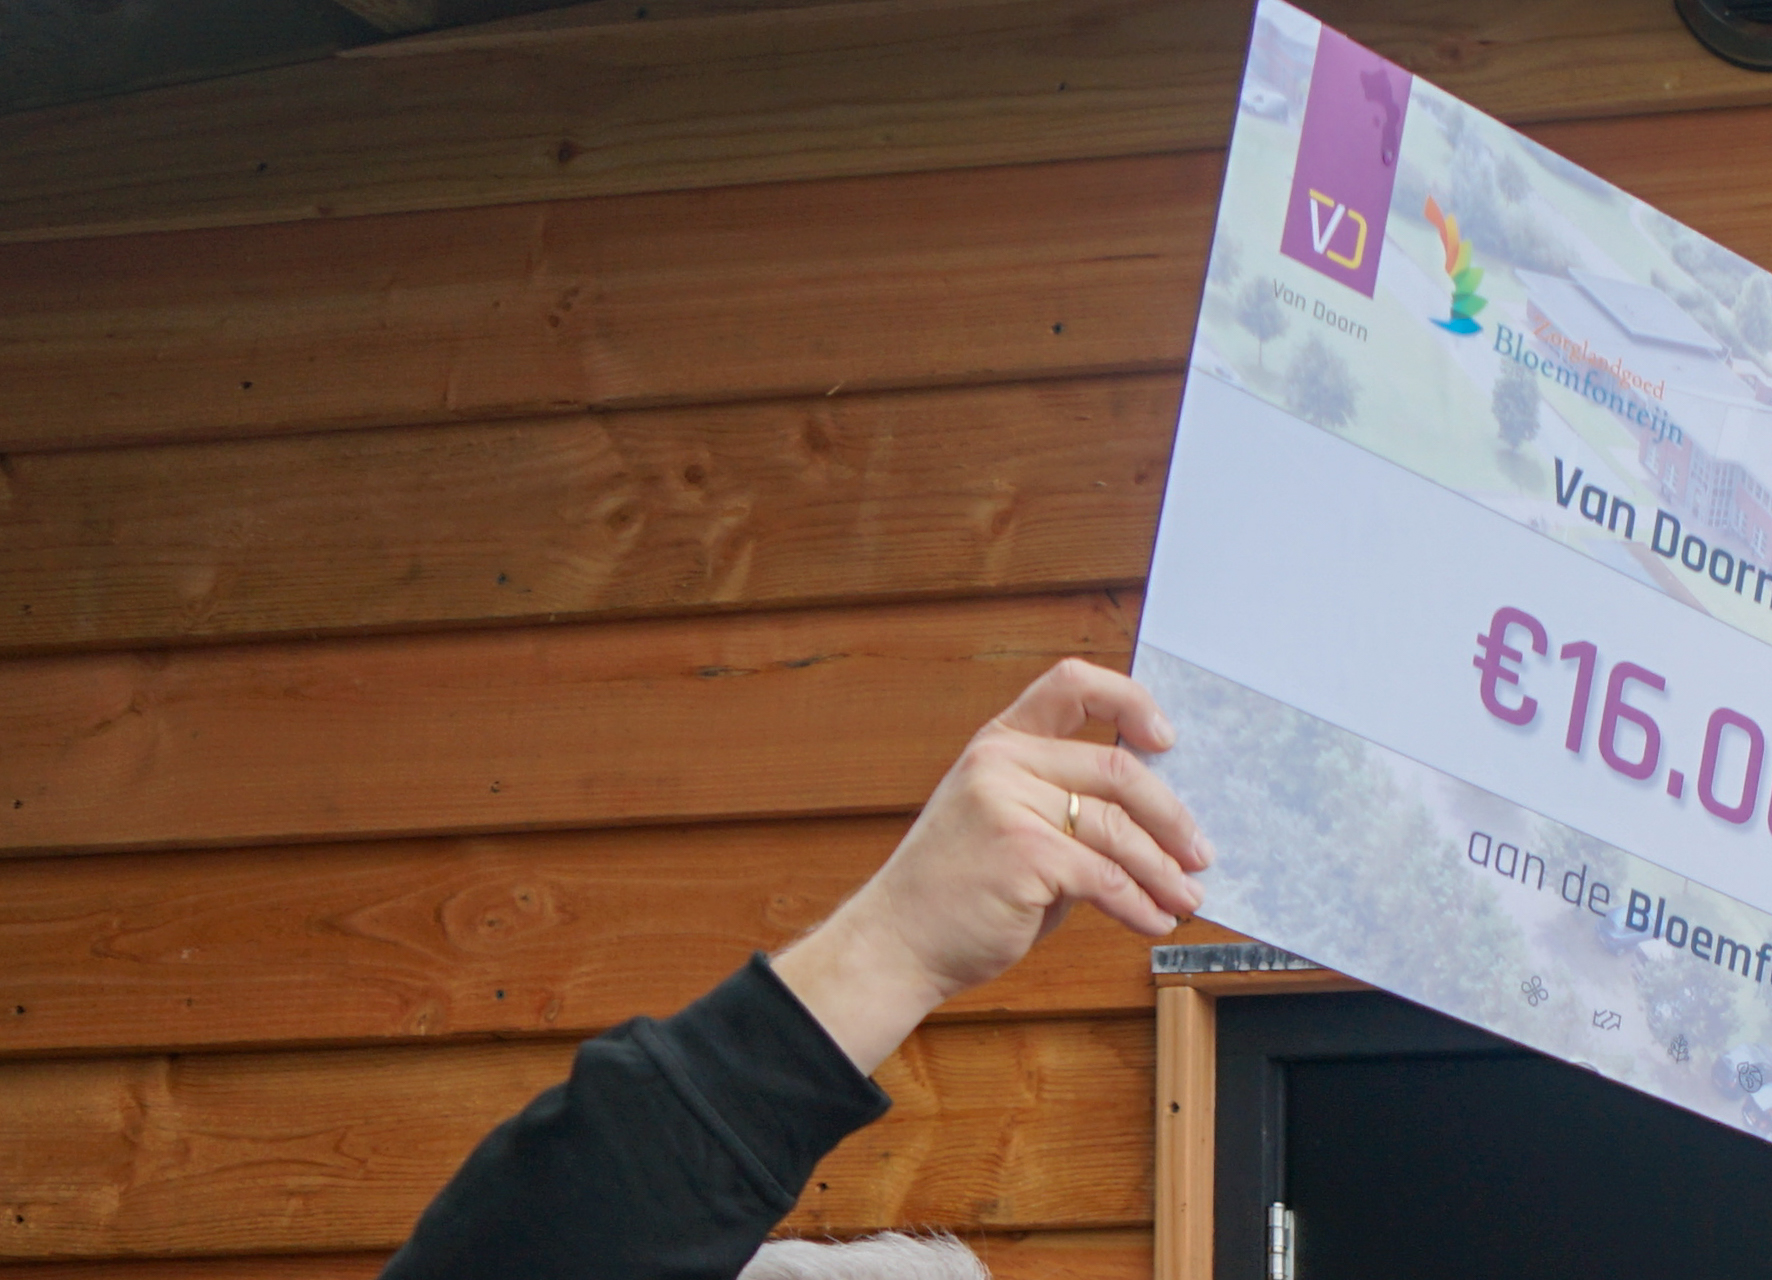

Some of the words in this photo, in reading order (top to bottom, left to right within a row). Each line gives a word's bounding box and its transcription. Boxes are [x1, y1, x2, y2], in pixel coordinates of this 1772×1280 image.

[1273, 278, 1306, 311] Van
[1313, 300, 1368, 342] Doorn
[1493, 323, 1684, 446] Bloemfonteijn
[1533, 315, 1665, 400] Zorglandgoed
[1554, 456, 1637, 540] Van
[1468, 831, 1545, 891] aan
[1561, 865, 1611, 918] de
